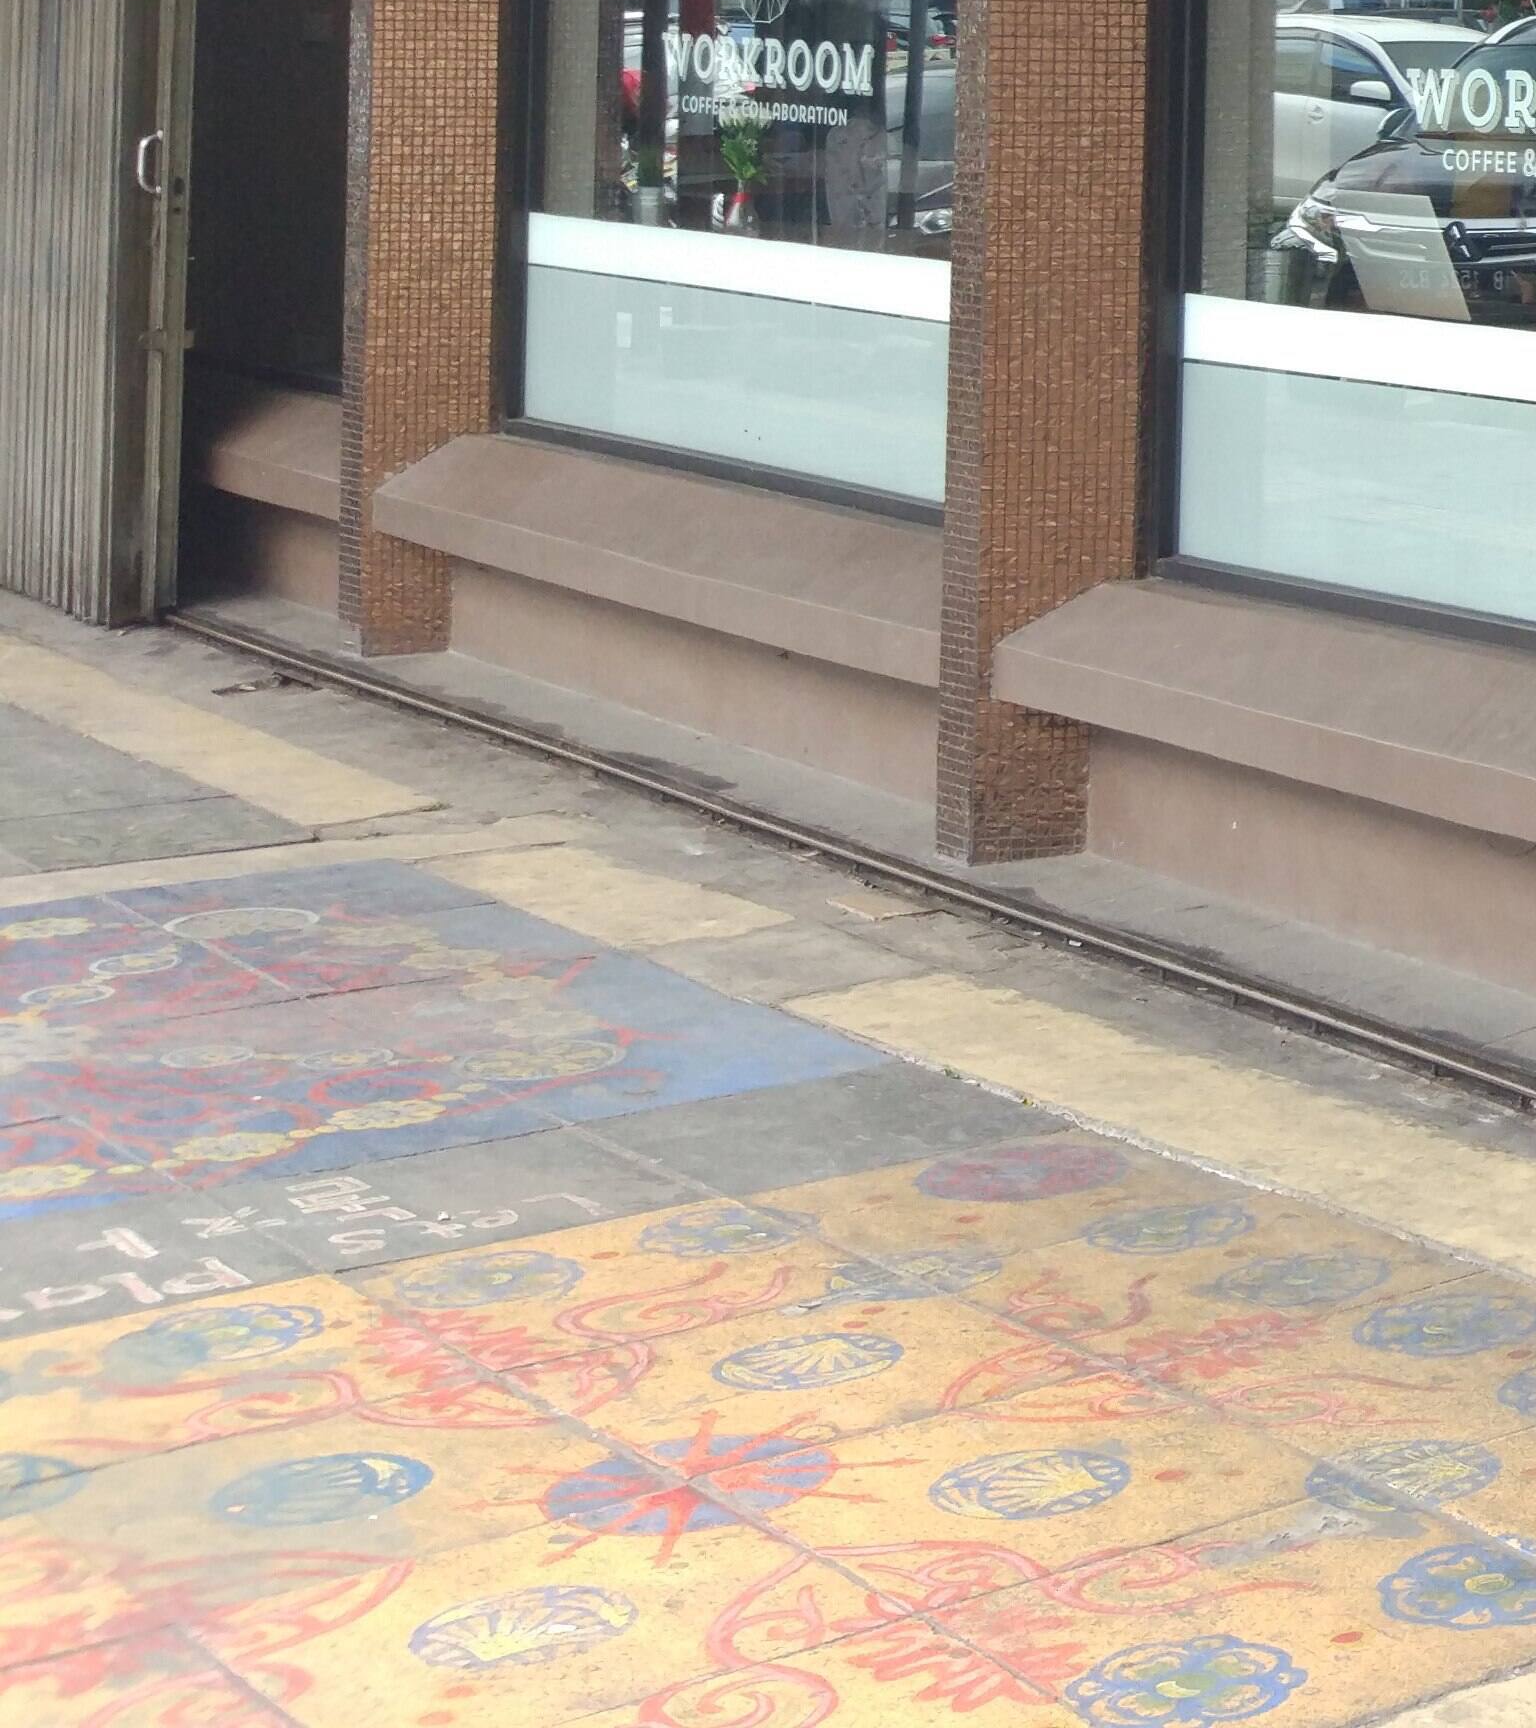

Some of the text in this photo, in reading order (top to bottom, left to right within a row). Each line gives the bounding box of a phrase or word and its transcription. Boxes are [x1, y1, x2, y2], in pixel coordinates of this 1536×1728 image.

[662, 30, 875, 97] WORKROOM
[682, 94, 726, 116] COFFEE
[741, 101, 849, 126] COLLABORATION
[1442, 149, 1518, 175] COFFEE
